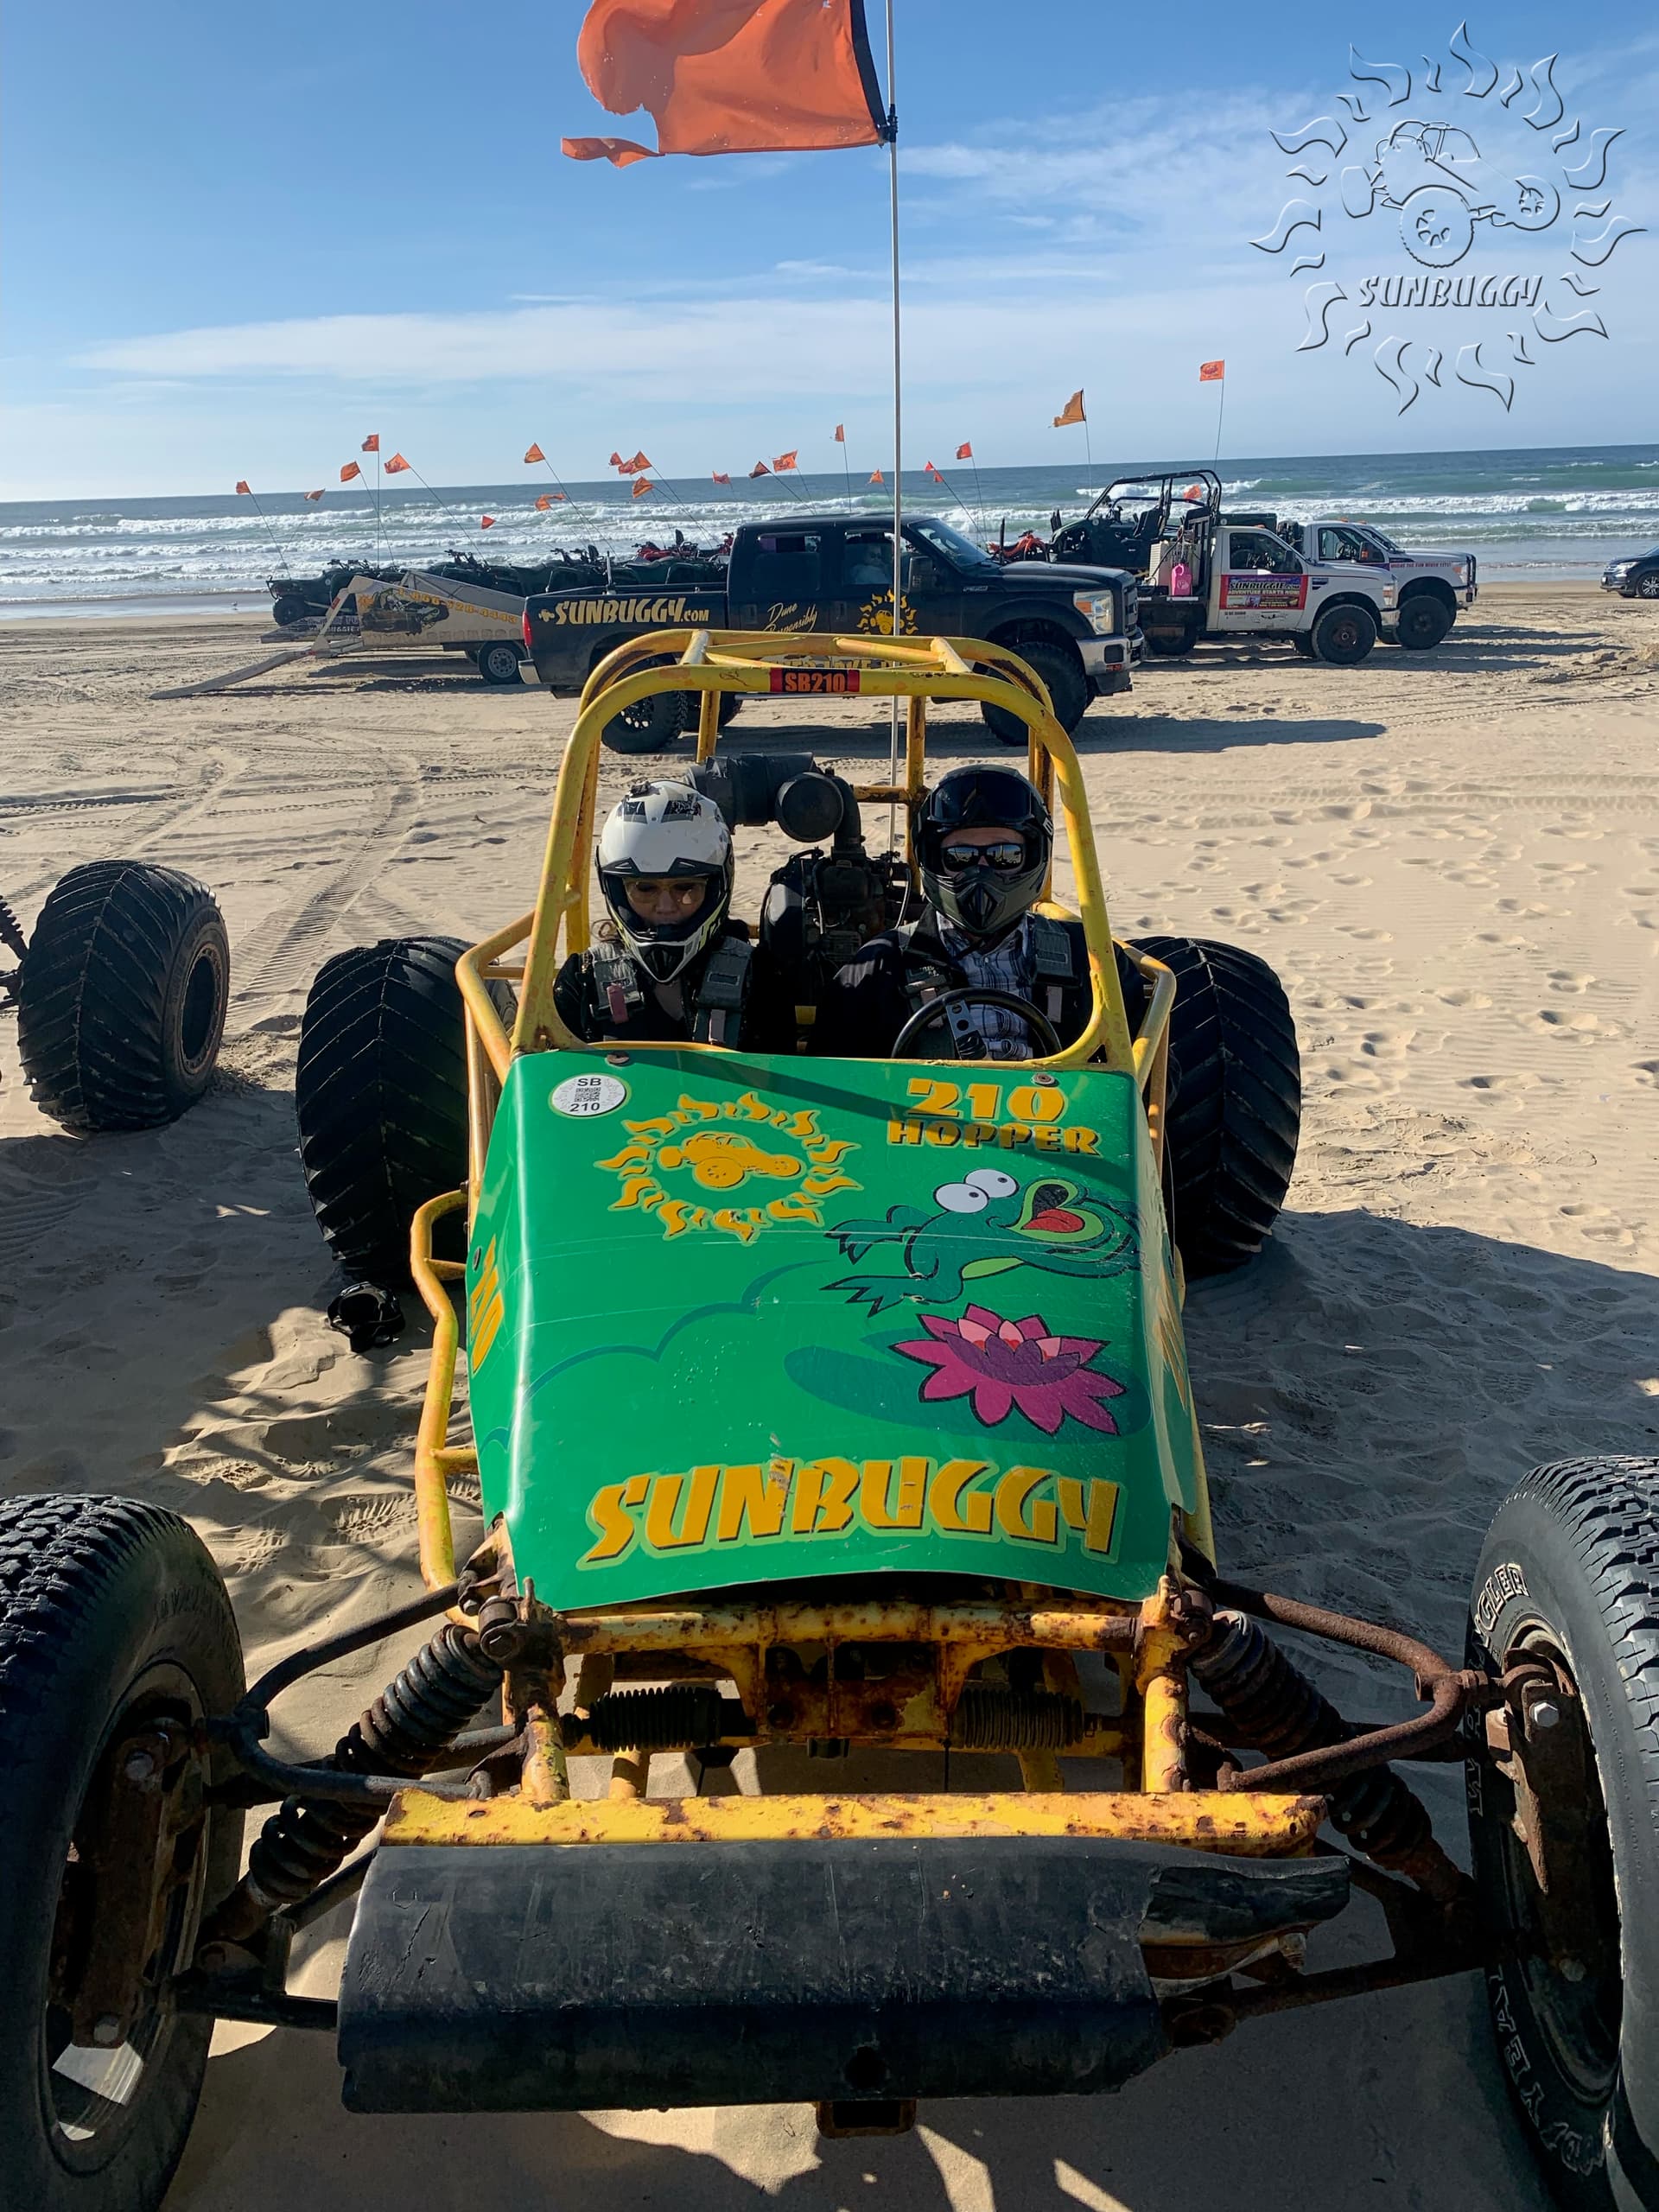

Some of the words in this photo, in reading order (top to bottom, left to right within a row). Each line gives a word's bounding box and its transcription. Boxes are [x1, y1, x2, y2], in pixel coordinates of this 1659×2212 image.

[766, 602, 798, 623] Dune
[785, 671, 846, 692] SB210
[577, 1077, 602, 1087] SB
[569, 1102, 601, 1112] 210
[907, 1077, 1065, 1122] 210
[887, 1119, 1103, 1157] HOPPER
[584, 1455, 1122, 1562] SUNBUGGY
